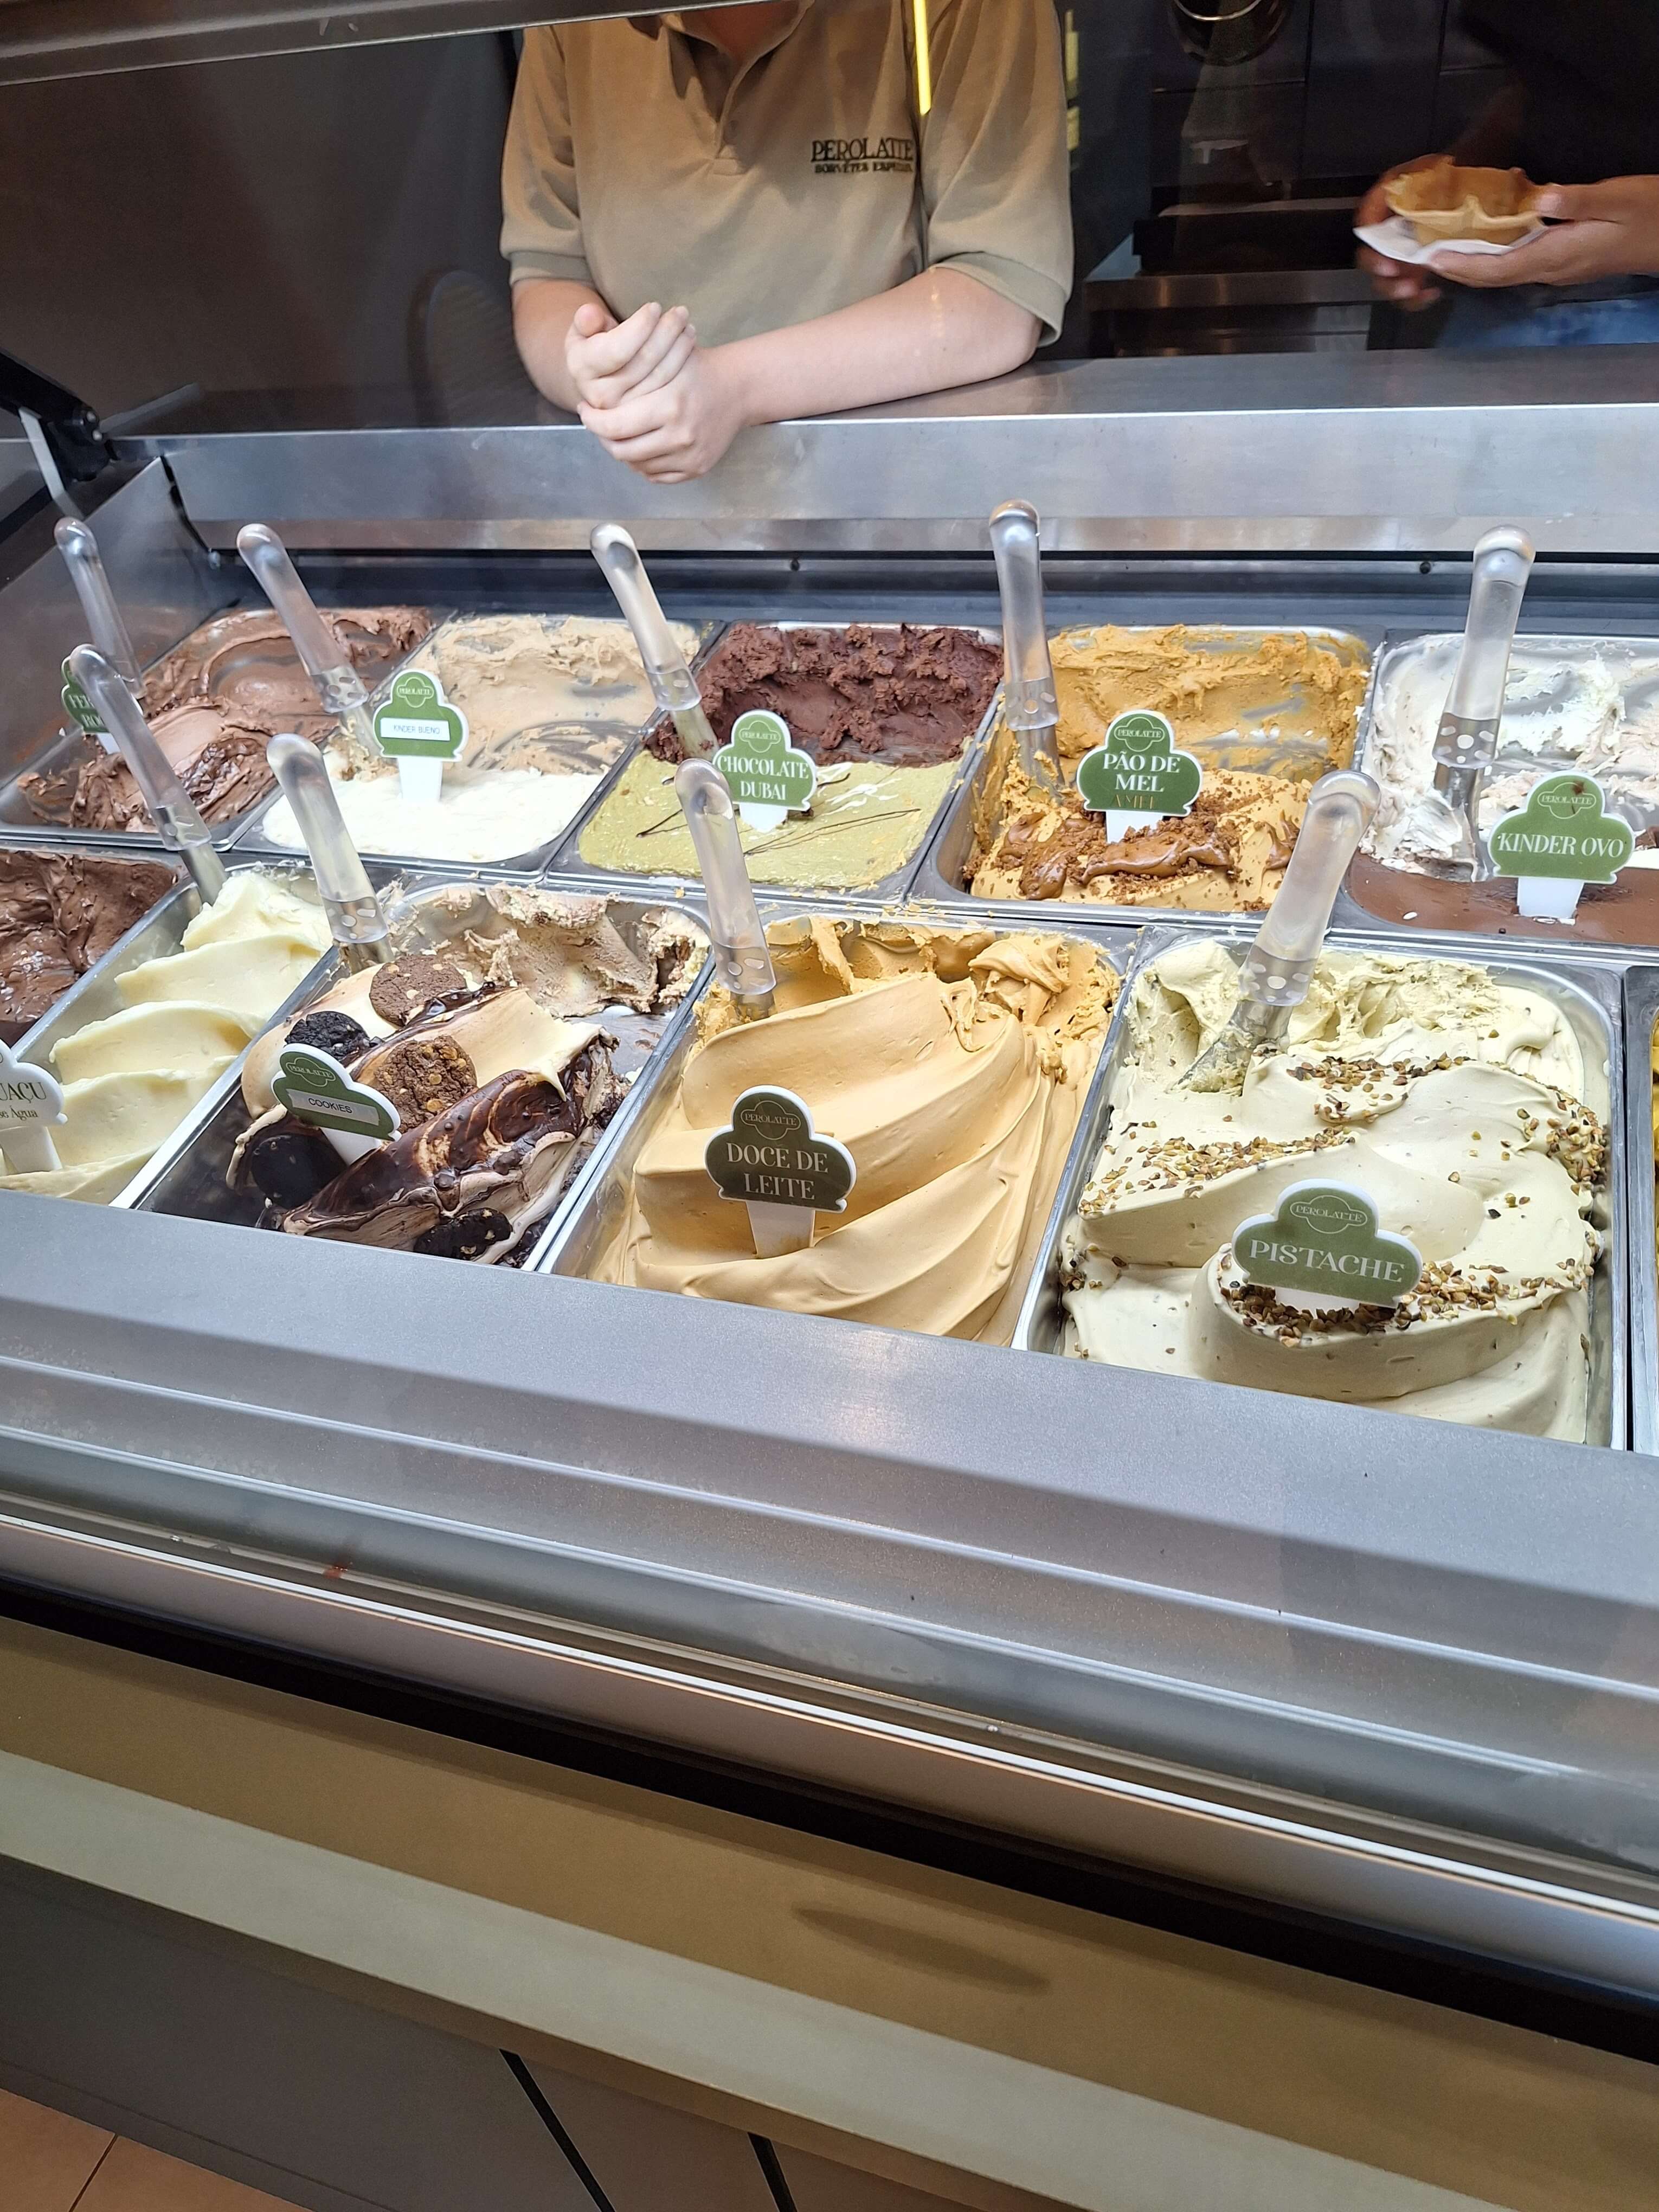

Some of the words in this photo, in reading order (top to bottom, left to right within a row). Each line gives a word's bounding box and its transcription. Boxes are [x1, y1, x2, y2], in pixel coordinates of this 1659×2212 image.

[811, 138, 914, 162] PEROLATTE
[394, 725, 416, 733] KINDER
[419, 726, 440, 734] BUENO
[1118, 729, 1161, 738] PEROLATTE
[717, 755, 809, 779] CHOCOLATE
[1103, 751, 1145, 771] PÃO
[1150, 756, 1180, 773] DE
[740, 781, 786, 800] DUBAI
[1115, 774, 1165, 792] MEL
[1541, 795, 1593, 805] PEROLATTE
[1498, 833, 1577, 856] KINDER
[1581, 837, 1624, 858] OVO
[10, 1105, 38, 1121] Água
[308, 1098, 352, 1114] COOKIES
[745, 1114, 797, 1126] PEROLATTE
[726, 1142, 790, 1169] DOCE
[796, 1150, 828, 1173] DE
[743, 1173, 815, 1200] LEITE
[1296, 1205, 1362, 1223] PEROLATTE
[1249, 1239, 1405, 1283] PISTACHE
